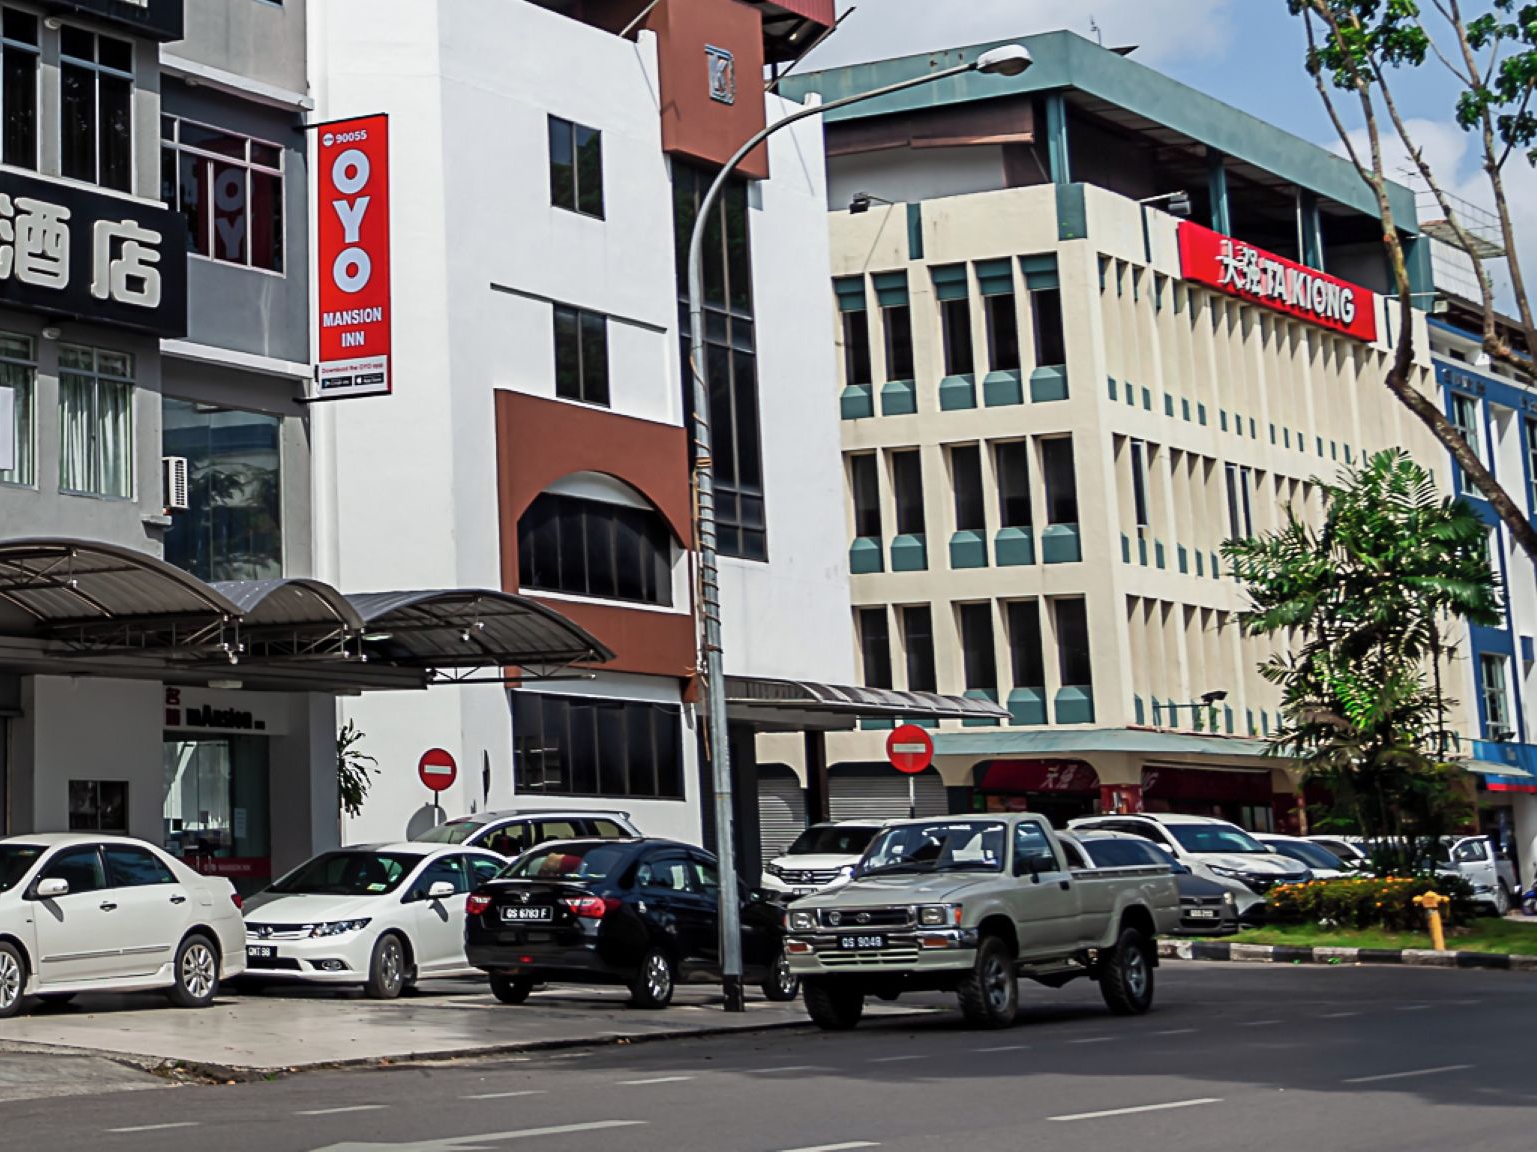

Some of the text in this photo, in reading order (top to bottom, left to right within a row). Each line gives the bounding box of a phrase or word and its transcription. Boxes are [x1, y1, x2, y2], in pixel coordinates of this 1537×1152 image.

[332, 149, 371, 293] OYO
[323, 307, 382, 327] MANSION
[341, 331, 365, 347] INN
